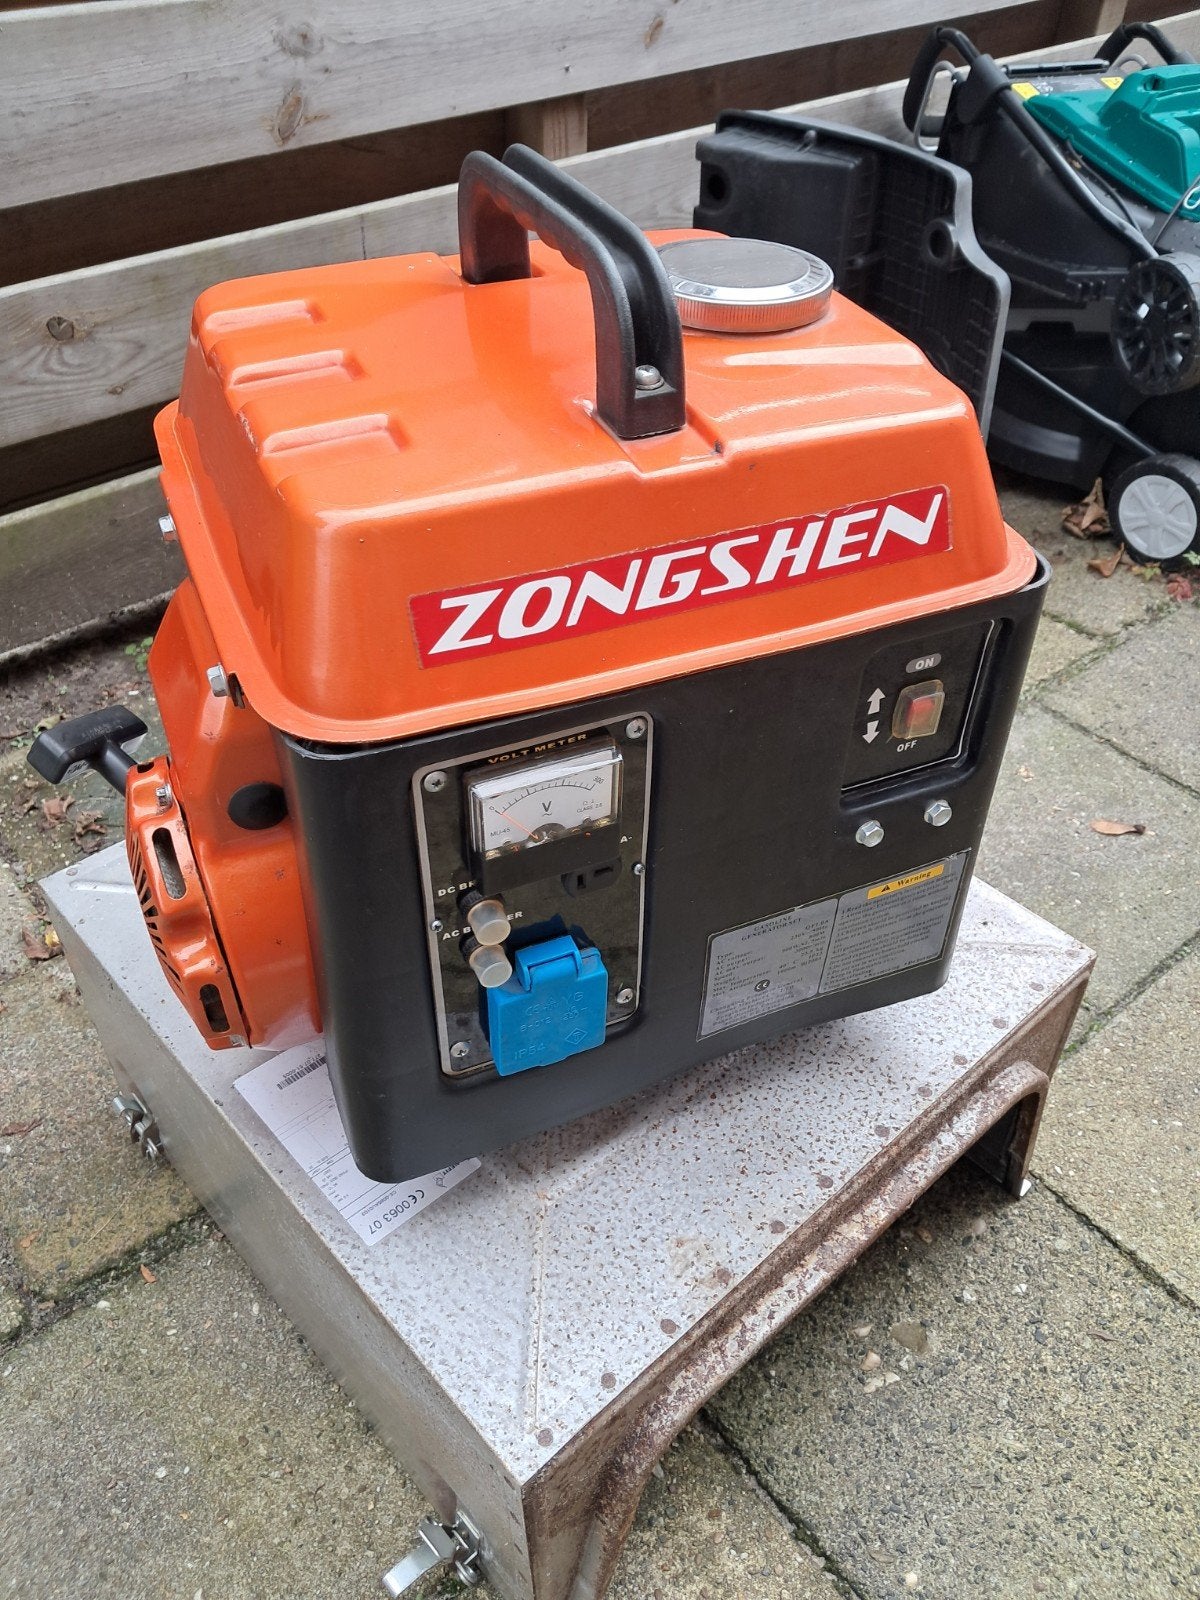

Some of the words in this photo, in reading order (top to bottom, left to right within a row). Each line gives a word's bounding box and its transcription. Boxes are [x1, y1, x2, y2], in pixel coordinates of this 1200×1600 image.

[428, 494, 943, 654] ZONGSHEN
[915, 657, 935, 670] ON
[487, 749, 530, 764] VOLT
[534, 733, 588, 753] METER
[896, 739, 918, 753] OFF
[896, 870, 931, 887] Warning
[437, 886, 456, 897] DC
[442, 929, 460, 941] AC
[366, 1219, 382, 1234] 07
